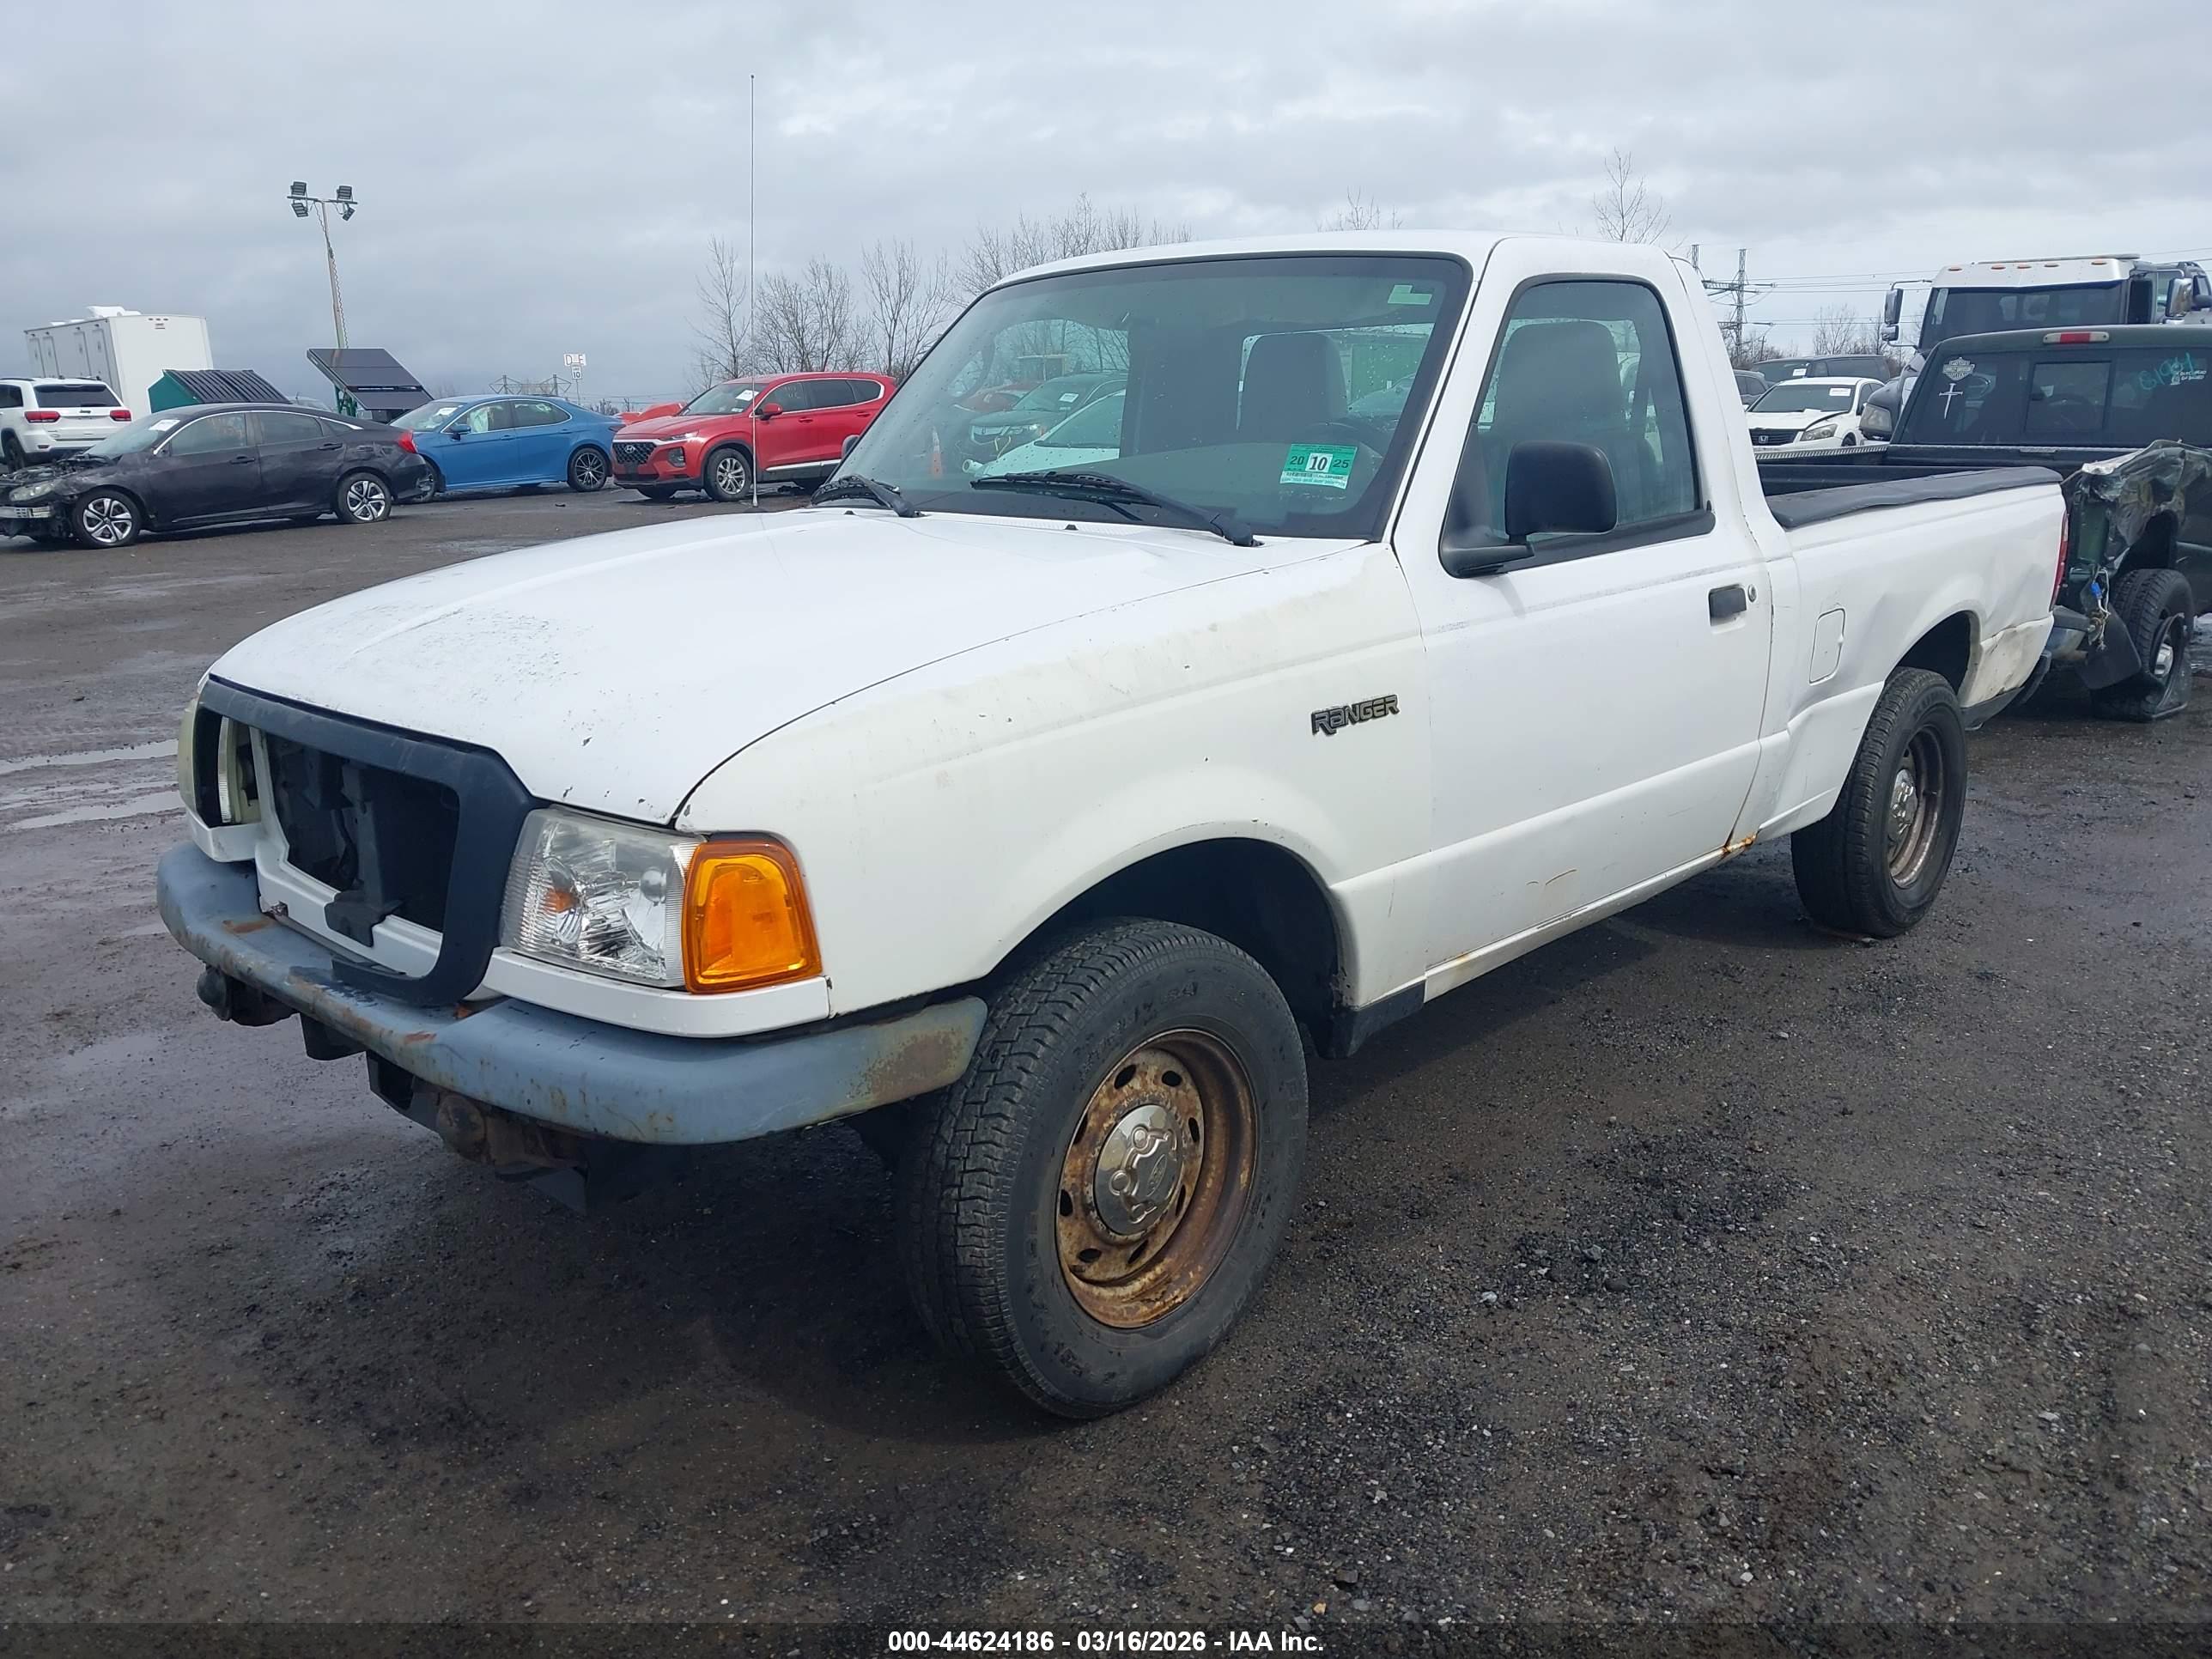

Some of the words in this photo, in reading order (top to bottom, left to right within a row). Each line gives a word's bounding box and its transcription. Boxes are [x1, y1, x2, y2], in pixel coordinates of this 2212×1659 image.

[1289, 455, 1306, 465] 20
[1309, 456, 1328, 471] 10
[1332, 459, 1351, 469] 25
[1310, 693, 1401, 737] RANGER
